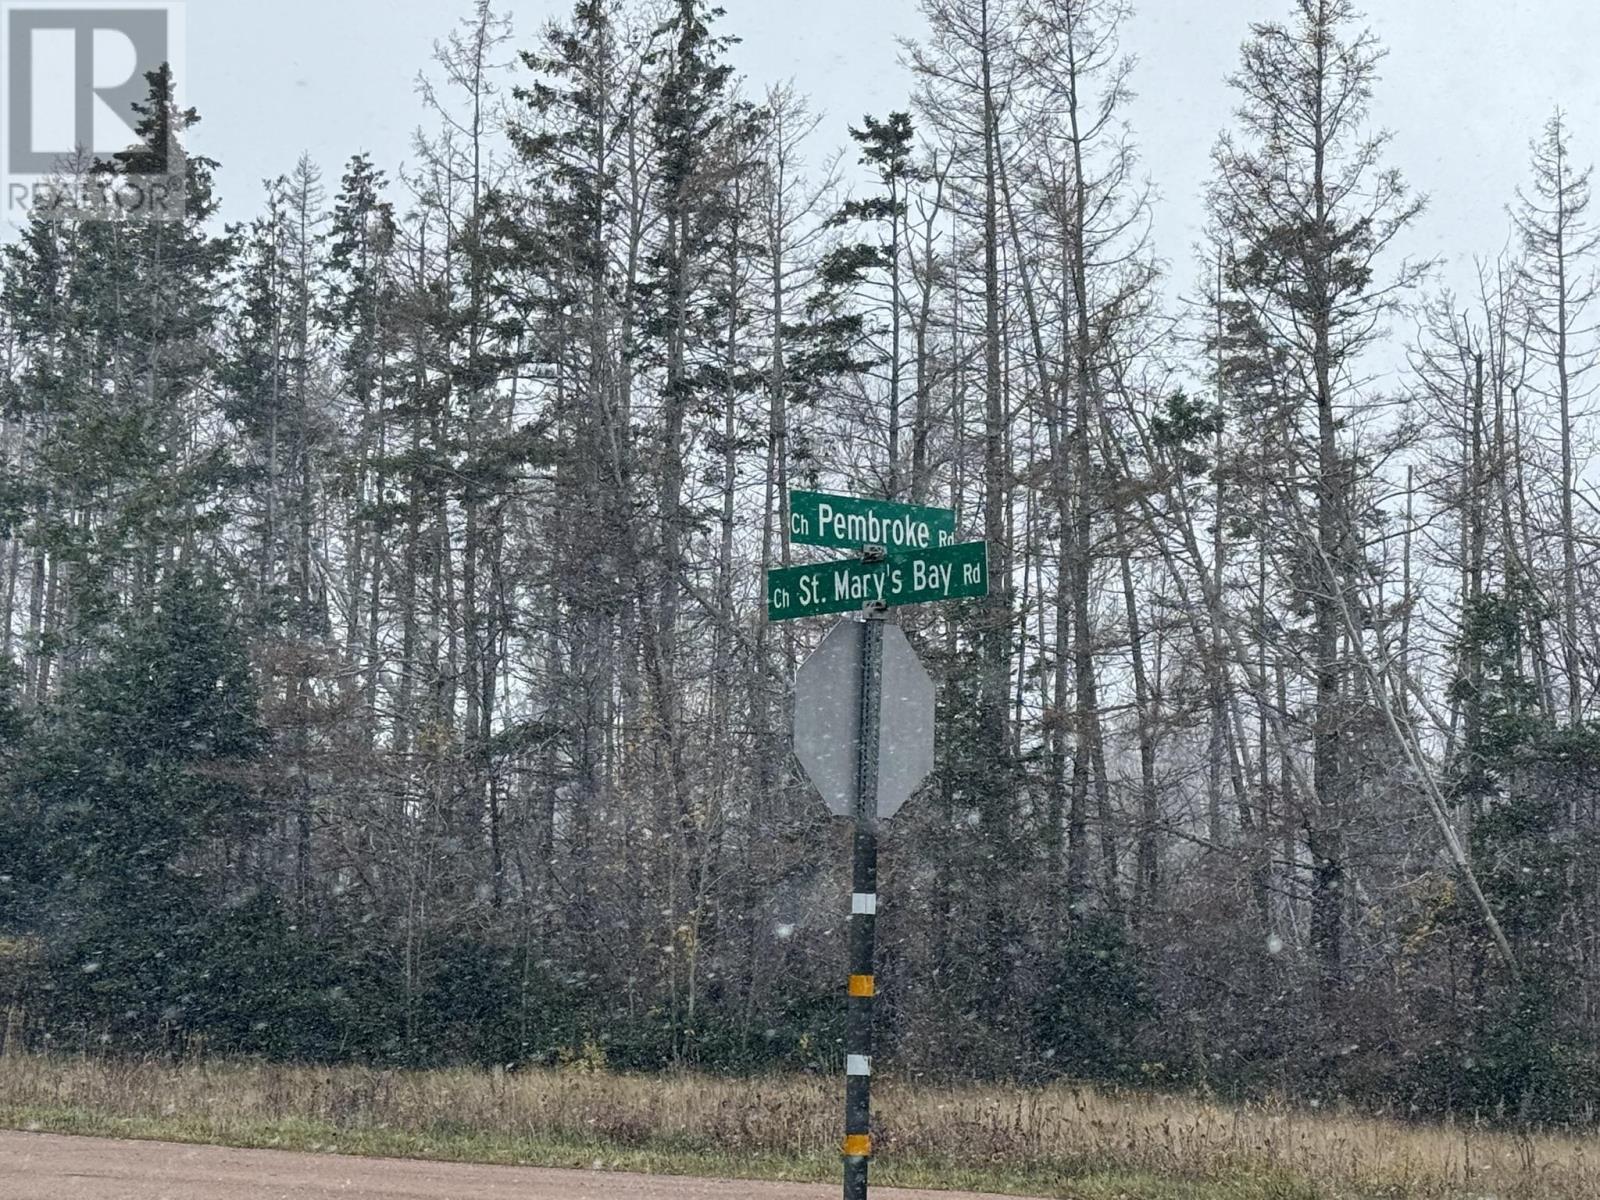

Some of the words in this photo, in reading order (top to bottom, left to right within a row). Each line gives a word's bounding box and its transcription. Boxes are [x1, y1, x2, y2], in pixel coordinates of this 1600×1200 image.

[791, 513, 809, 536] Ch
[819, 503, 930, 548] Pembroke
[938, 530, 955, 547] Rd
[774, 588, 790, 609] Ch
[799, 574, 826, 605] St.
[834, 564, 902, 601] Mary's
[913, 560, 952, 596] Bay
[963, 563, 981, 586] Rd
